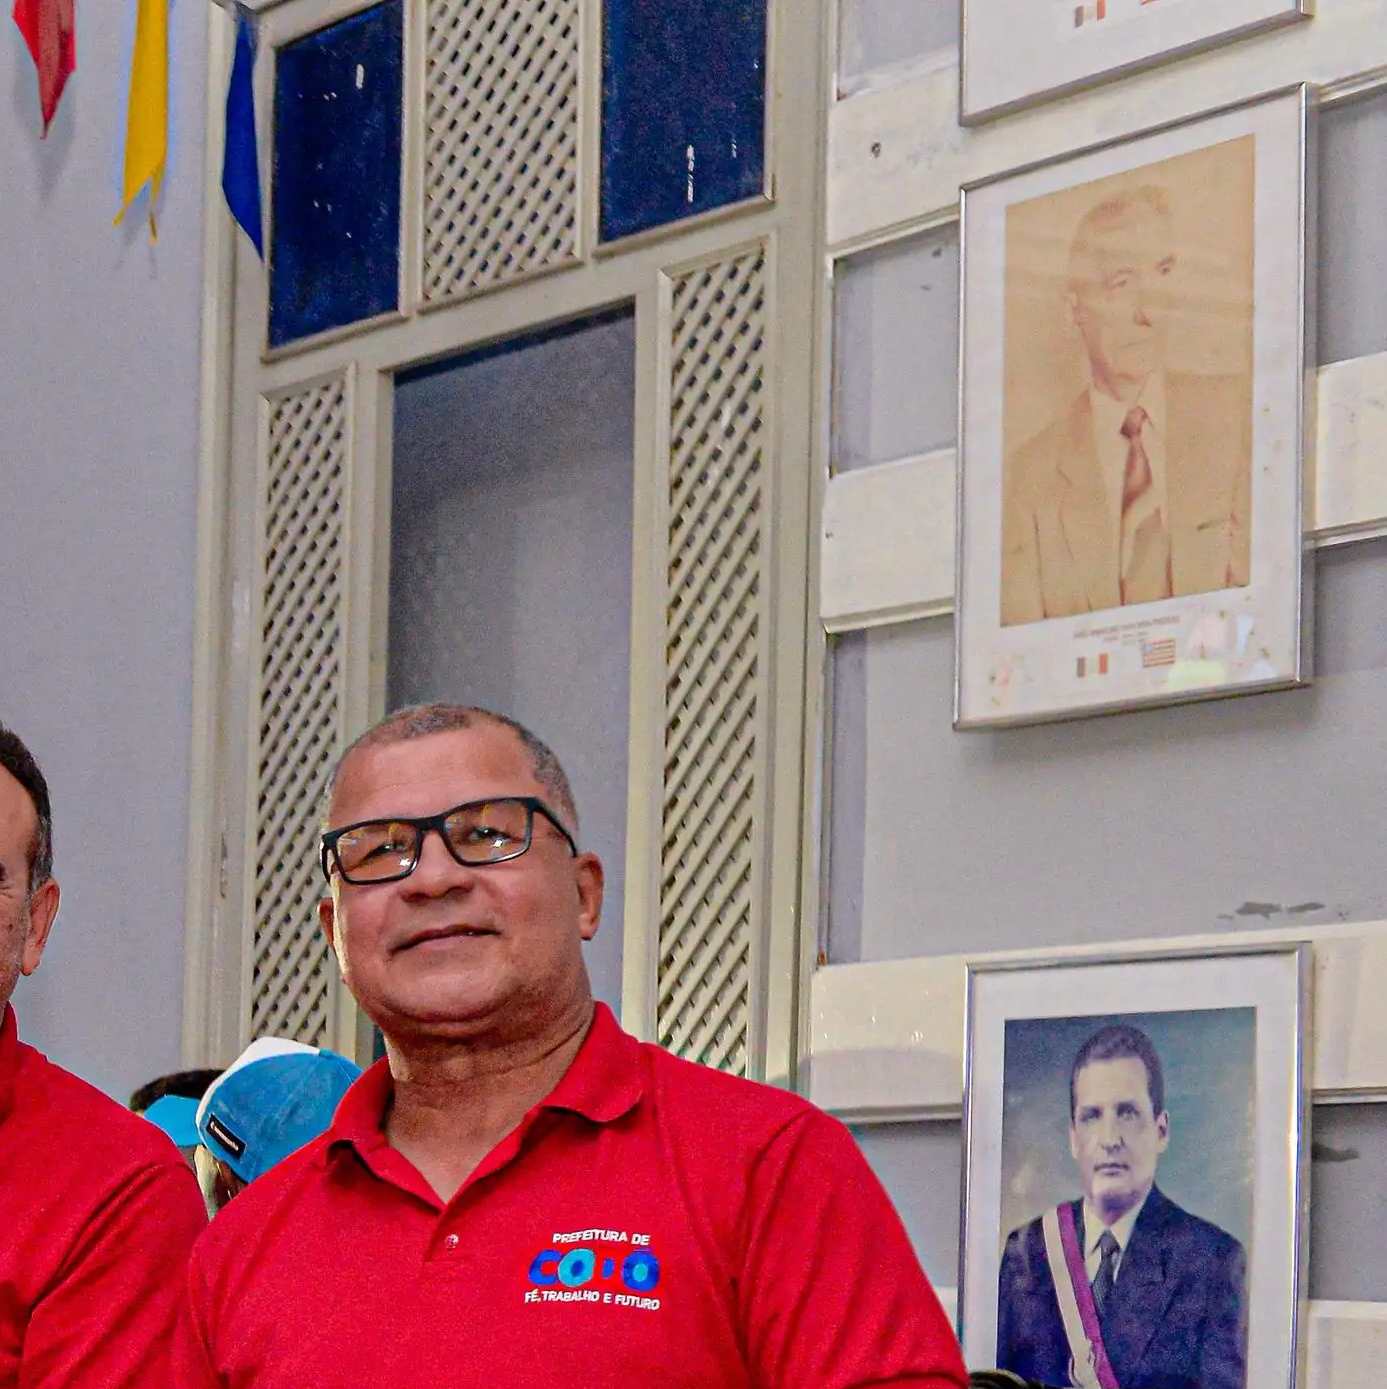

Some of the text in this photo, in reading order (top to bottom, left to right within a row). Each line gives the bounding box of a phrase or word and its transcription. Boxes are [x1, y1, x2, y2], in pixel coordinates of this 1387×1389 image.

[553, 1229, 651, 1246] PREFEITURA DE
[542, 1290, 600, 1303] TRABALHO
[603, 1292, 613, 1304] E
[615, 1294, 661, 1311] FUTURO
